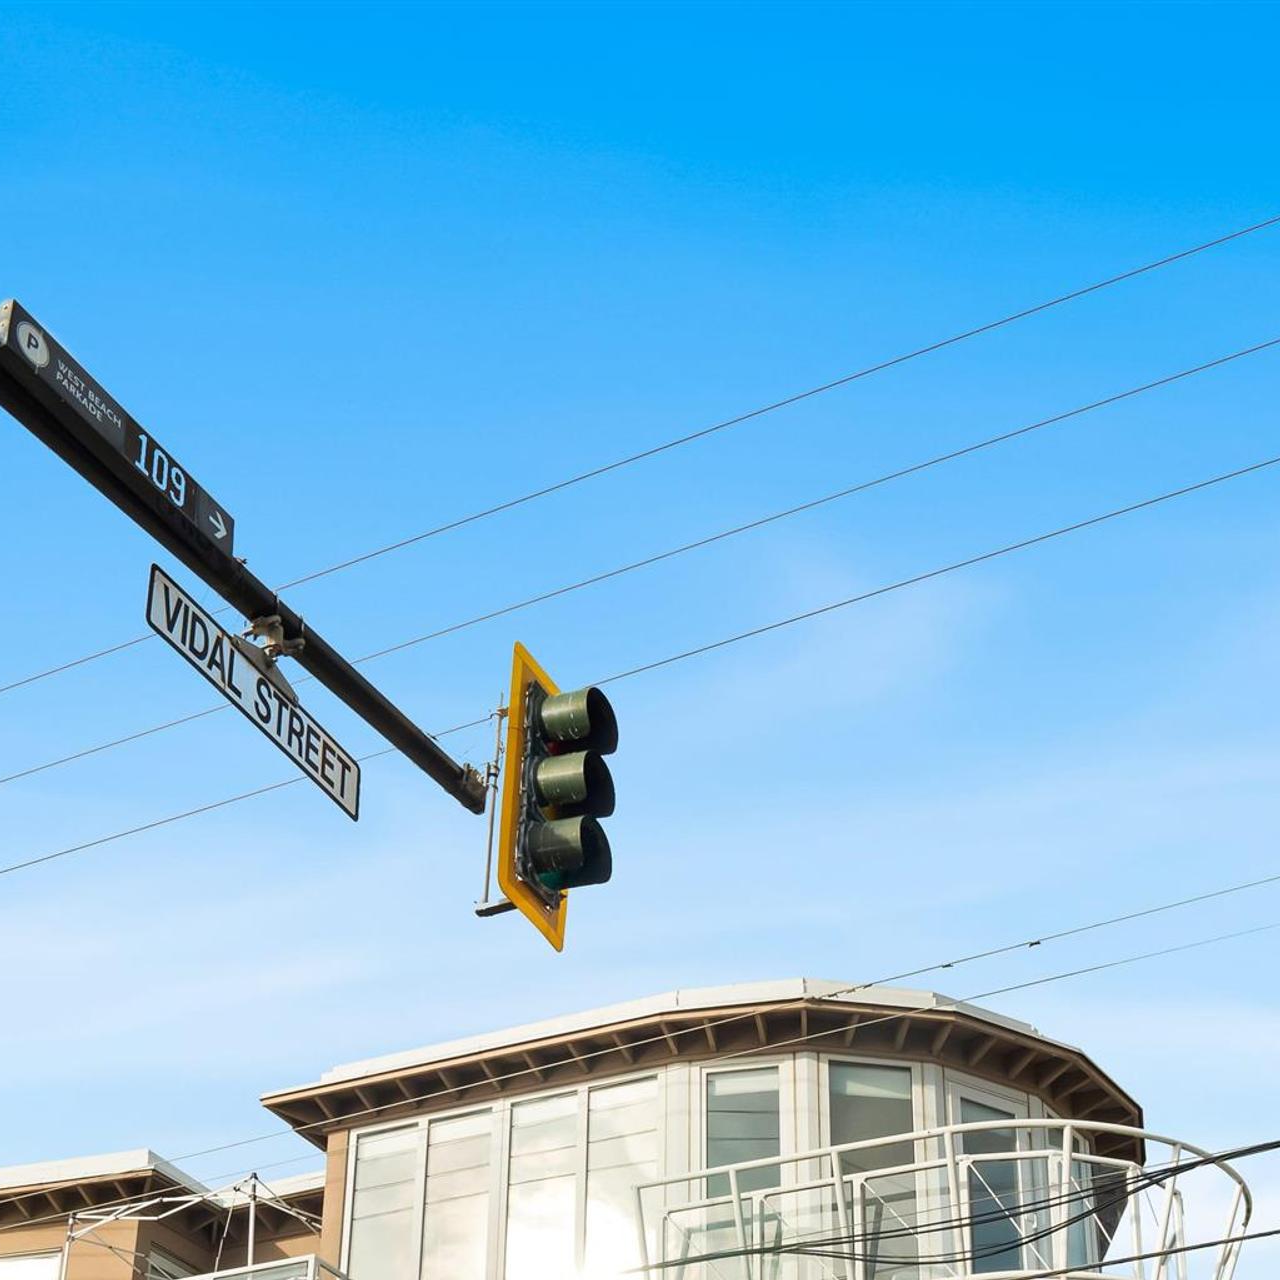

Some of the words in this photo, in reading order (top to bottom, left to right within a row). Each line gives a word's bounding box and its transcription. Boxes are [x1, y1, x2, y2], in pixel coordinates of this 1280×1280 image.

[27, 332, 39, 350] P
[56, 371, 103, 422] PARKADE
[57, 359, 85, 391] WEST
[88, 390, 122, 428] BEACH
[135, 433, 186, 507] 109
[163, 583, 242, 699] VIDAL
[254, 677, 351, 799] STREET
